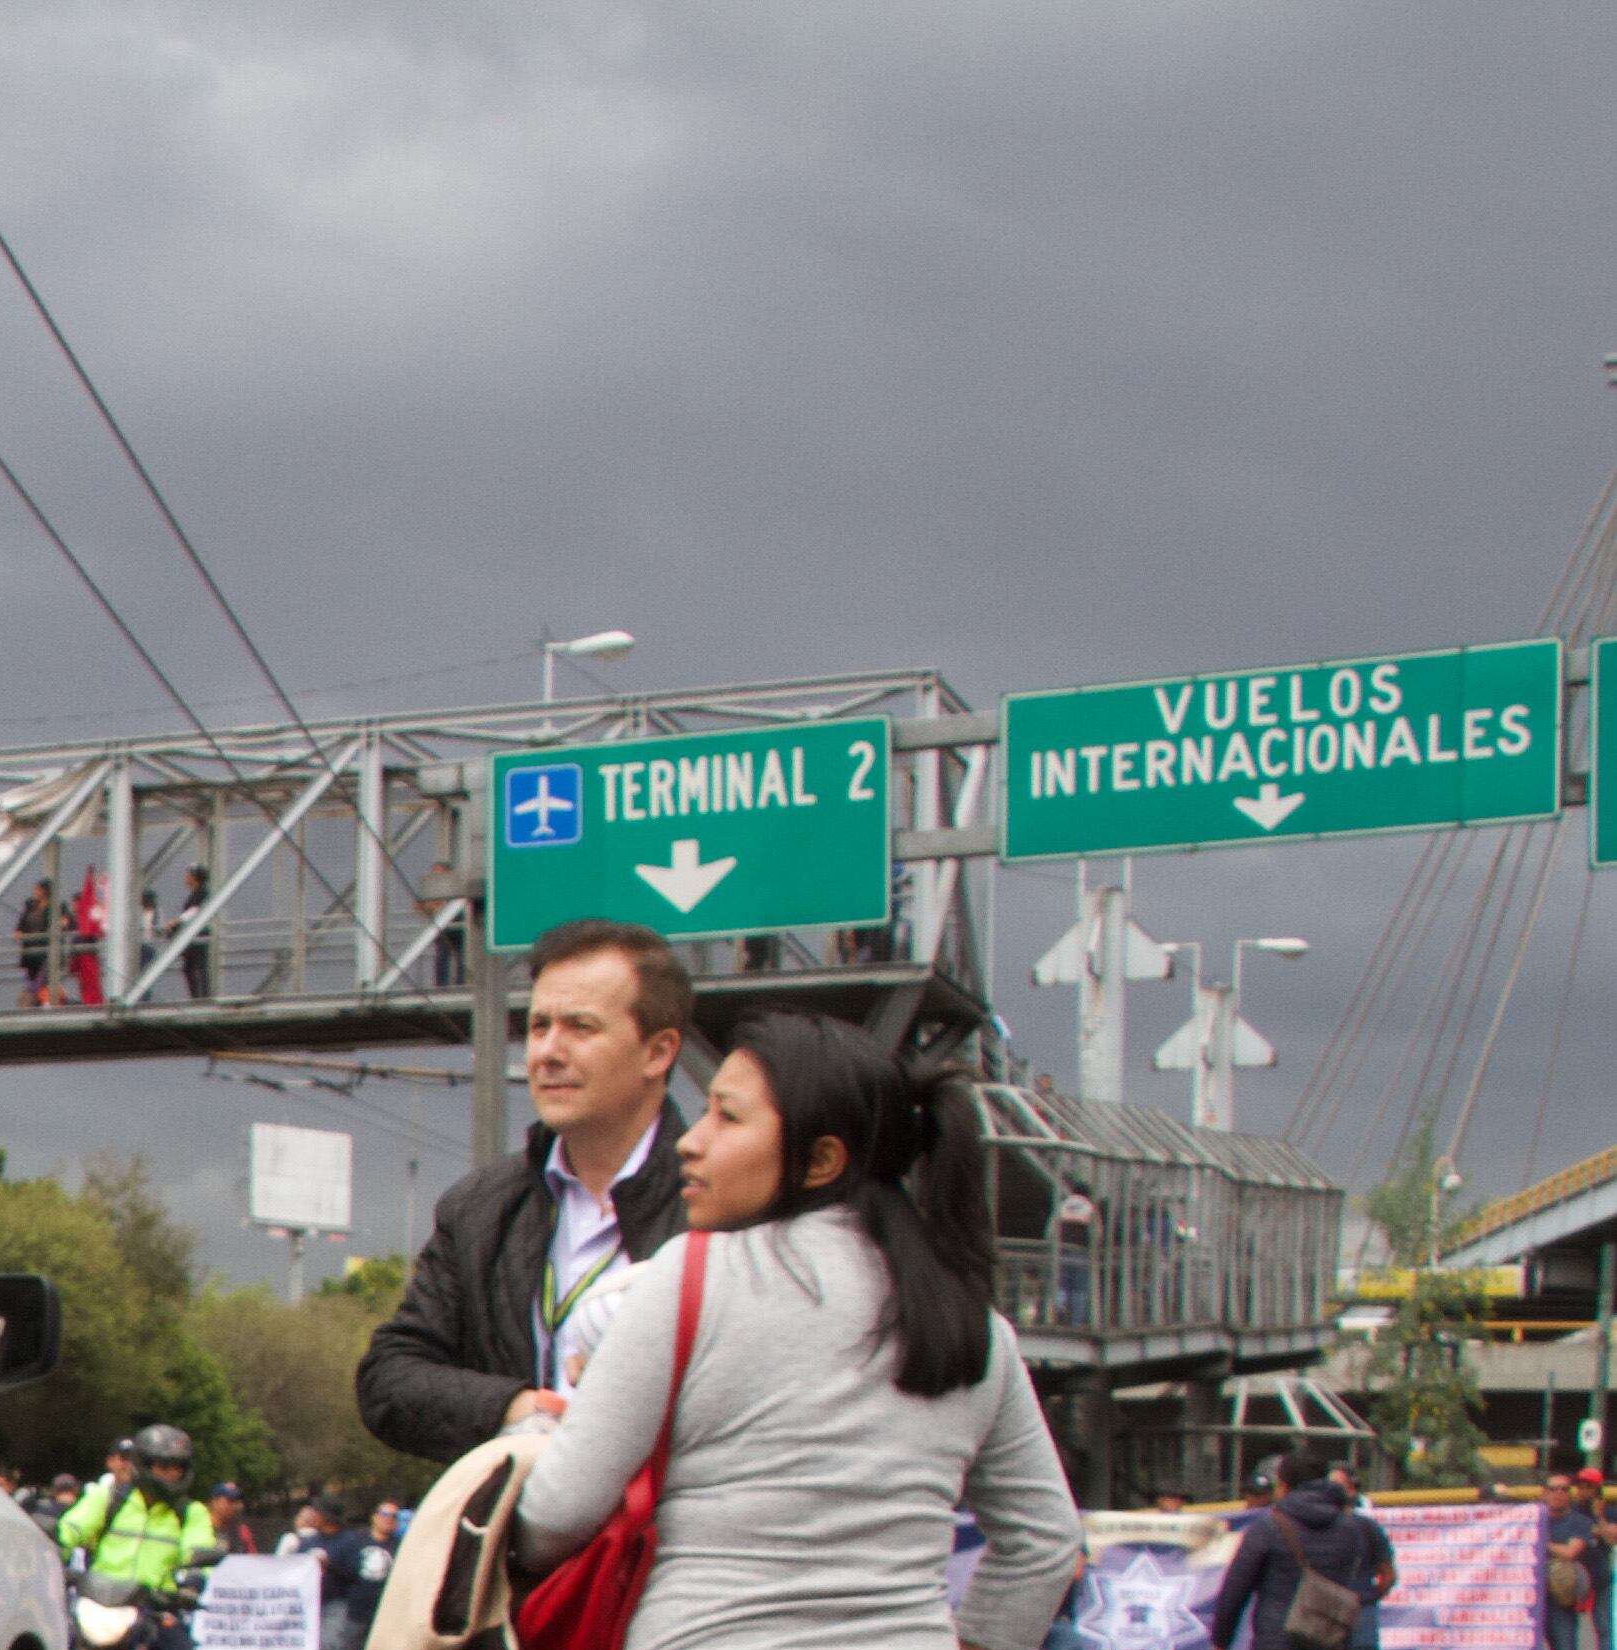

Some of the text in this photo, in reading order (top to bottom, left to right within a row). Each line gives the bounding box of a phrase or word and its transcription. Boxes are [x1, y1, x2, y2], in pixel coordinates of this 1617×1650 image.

[1153, 663, 1404, 735] VUELOS
[598, 739, 877, 823] TERMINAL 2
[1030, 703, 1533, 799] INTERNACIONALES
